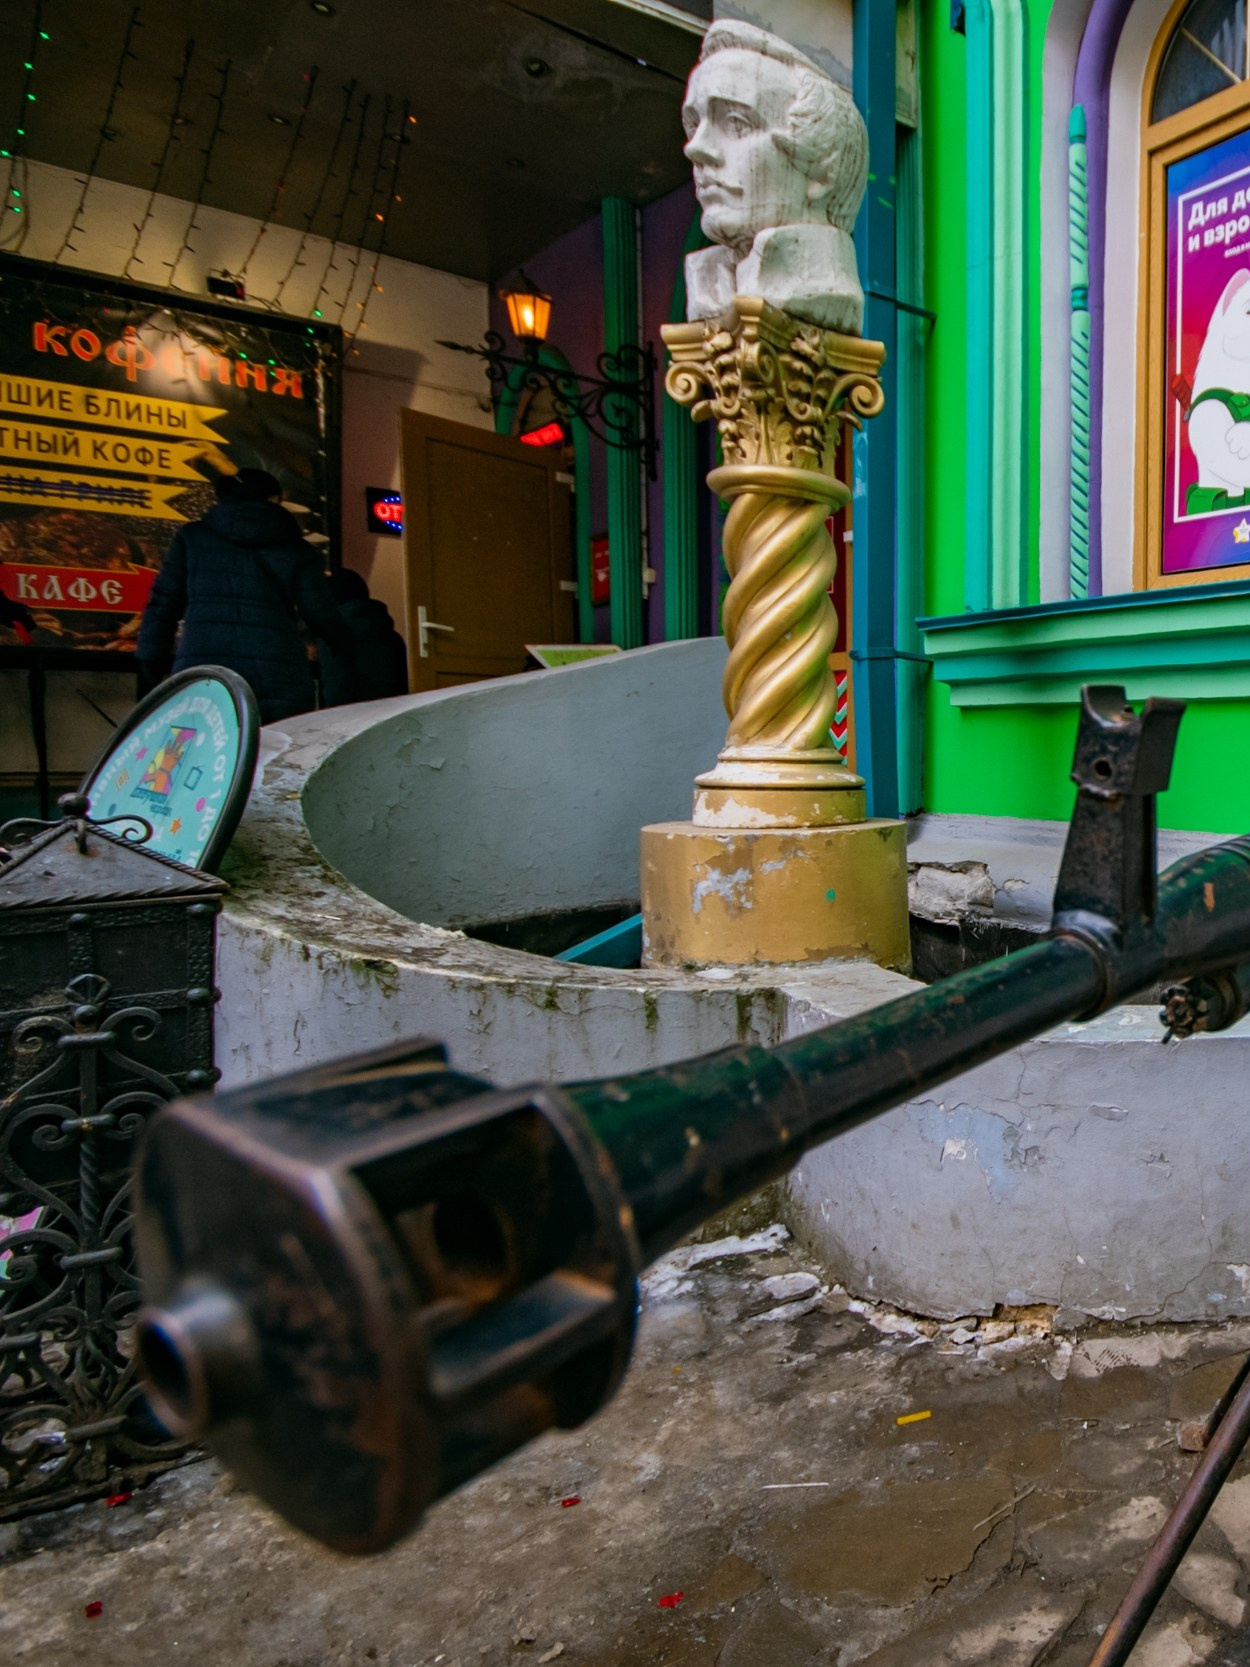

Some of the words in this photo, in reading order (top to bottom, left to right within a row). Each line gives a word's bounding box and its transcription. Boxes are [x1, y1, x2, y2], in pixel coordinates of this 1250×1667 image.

[1188, 196, 1228, 232] Для
[1188, 233, 1201, 253] и
[0, 381, 73, 413] ШИЕ
[86, 393, 188, 430] БЛИНЫ
[92, 439, 172, 470] КОФЕ
[16, 573, 123, 605] КАФЕ
